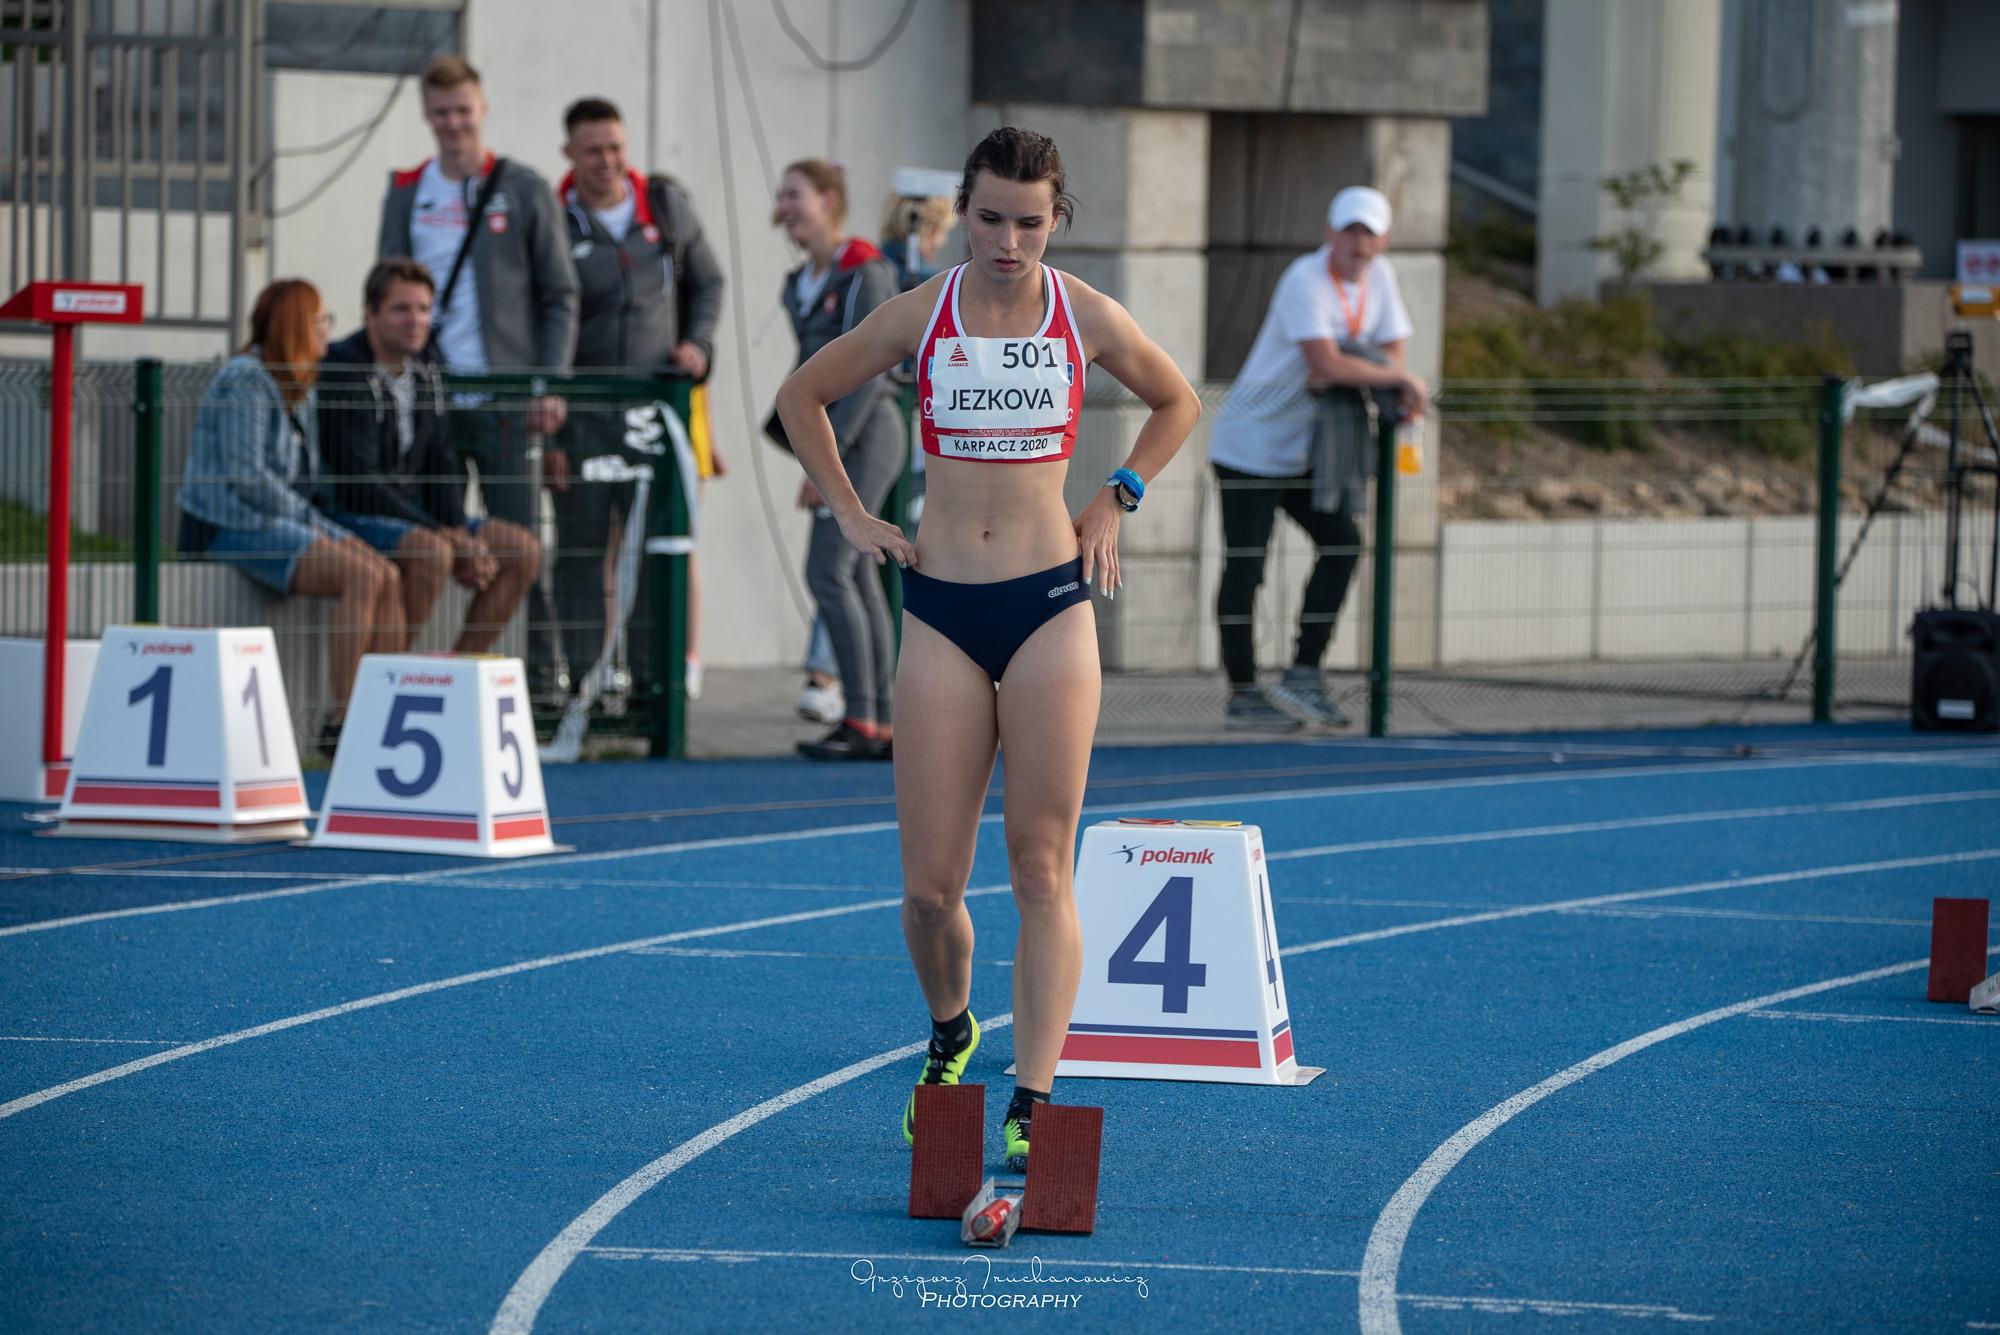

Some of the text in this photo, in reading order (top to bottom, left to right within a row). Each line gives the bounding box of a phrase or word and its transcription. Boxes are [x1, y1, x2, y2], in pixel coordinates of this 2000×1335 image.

[1002, 341, 1058, 369] 501
[948, 388, 1054, 411] JEZKOVA
[954, 438, 1048, 452] KARPACZ 2020
[1048, 581, 1079, 598] eleven
[141, 640, 196, 658] polanik
[399, 672, 455, 689] polanik
[128, 666, 173, 767] 1
[242, 666, 271, 767] 1
[376, 694, 445, 798] 5
[497, 697, 524, 799] 5
[1140, 846, 1215, 866] polanik
[1107, 876, 1207, 1014] 4
[1258, 873, 1280, 1010] 4
